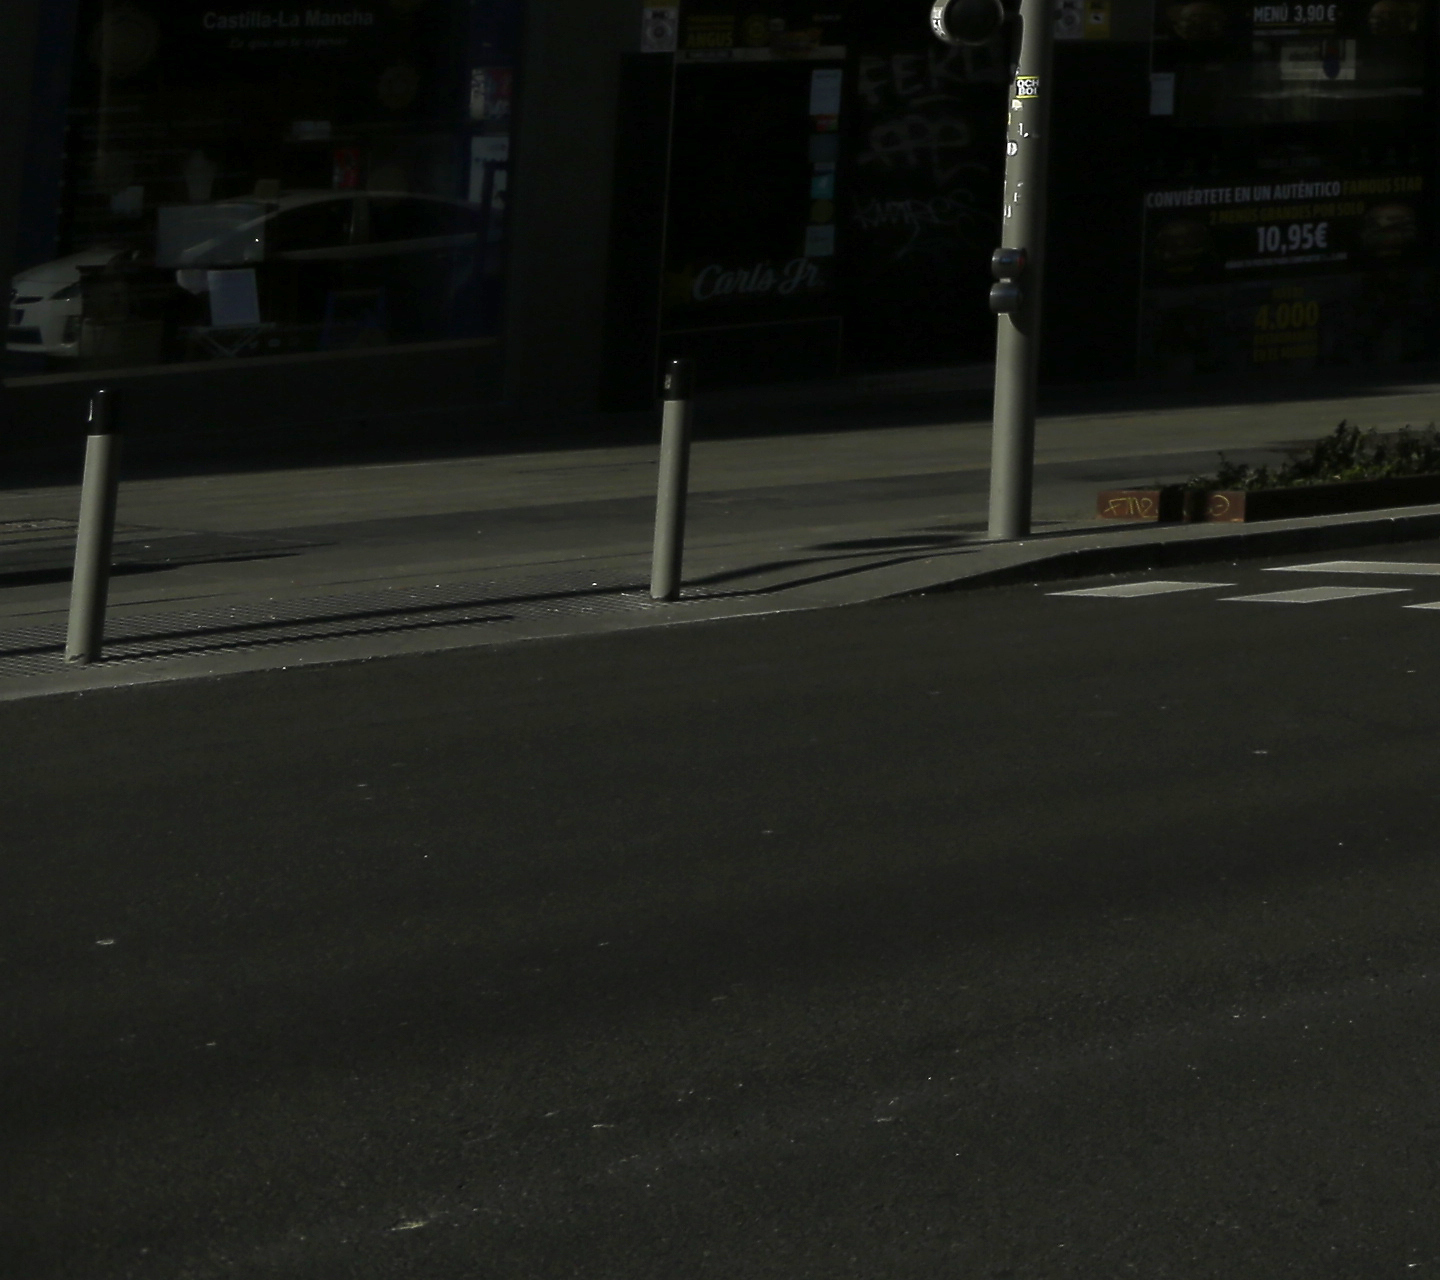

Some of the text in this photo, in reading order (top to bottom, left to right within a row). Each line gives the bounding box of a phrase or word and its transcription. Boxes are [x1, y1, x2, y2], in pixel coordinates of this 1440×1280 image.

[202, 8, 374, 31] Castilla-La Mancha
[1234, 185, 1251, 203] EN
[1252, 183, 1272, 202] UN
[1256, 221, 1329, 255] 10,95€
